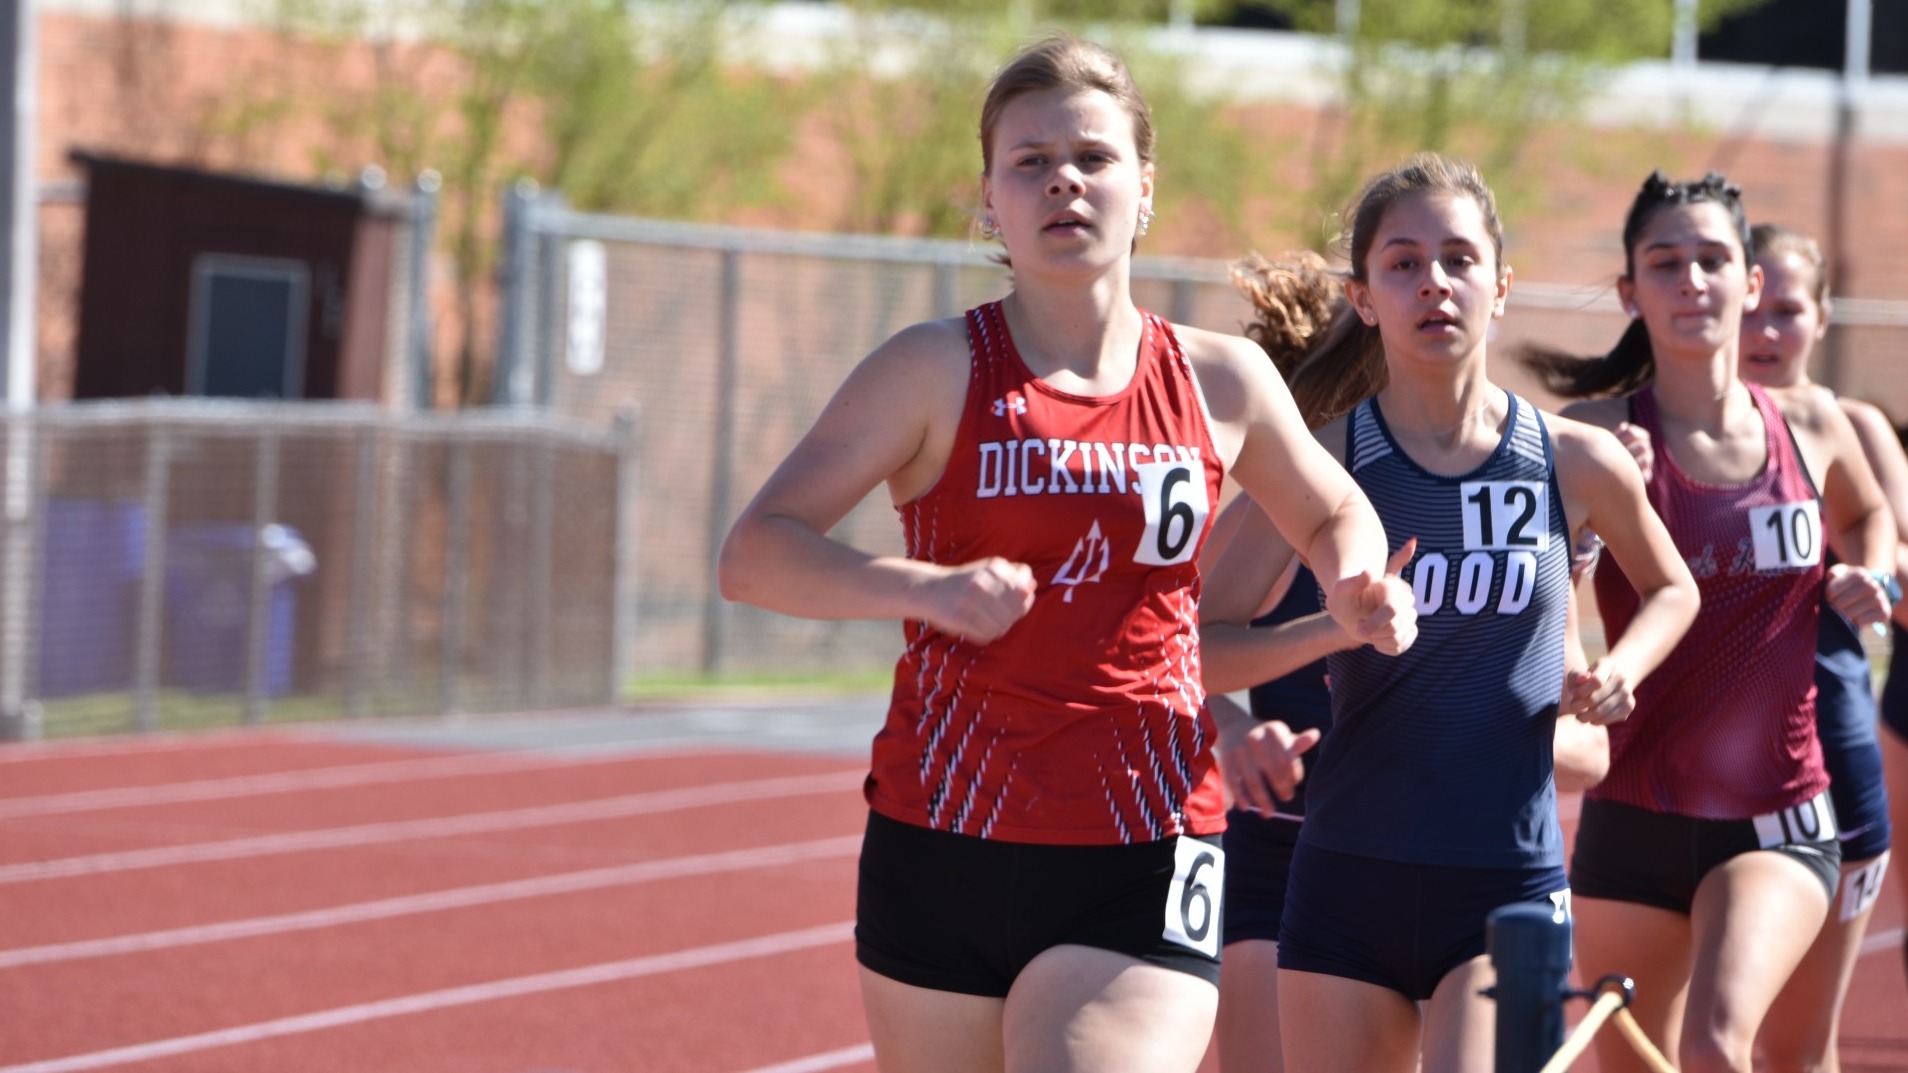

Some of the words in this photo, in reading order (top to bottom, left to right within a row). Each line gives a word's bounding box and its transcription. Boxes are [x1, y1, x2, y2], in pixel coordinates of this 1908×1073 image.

[1157, 467, 1195, 560] 6
[1468, 486, 1538, 546] 12
[1766, 508, 1812, 563] 10
[1399, 552, 1538, 616] OOD
[1180, 851, 1215, 942] 6
